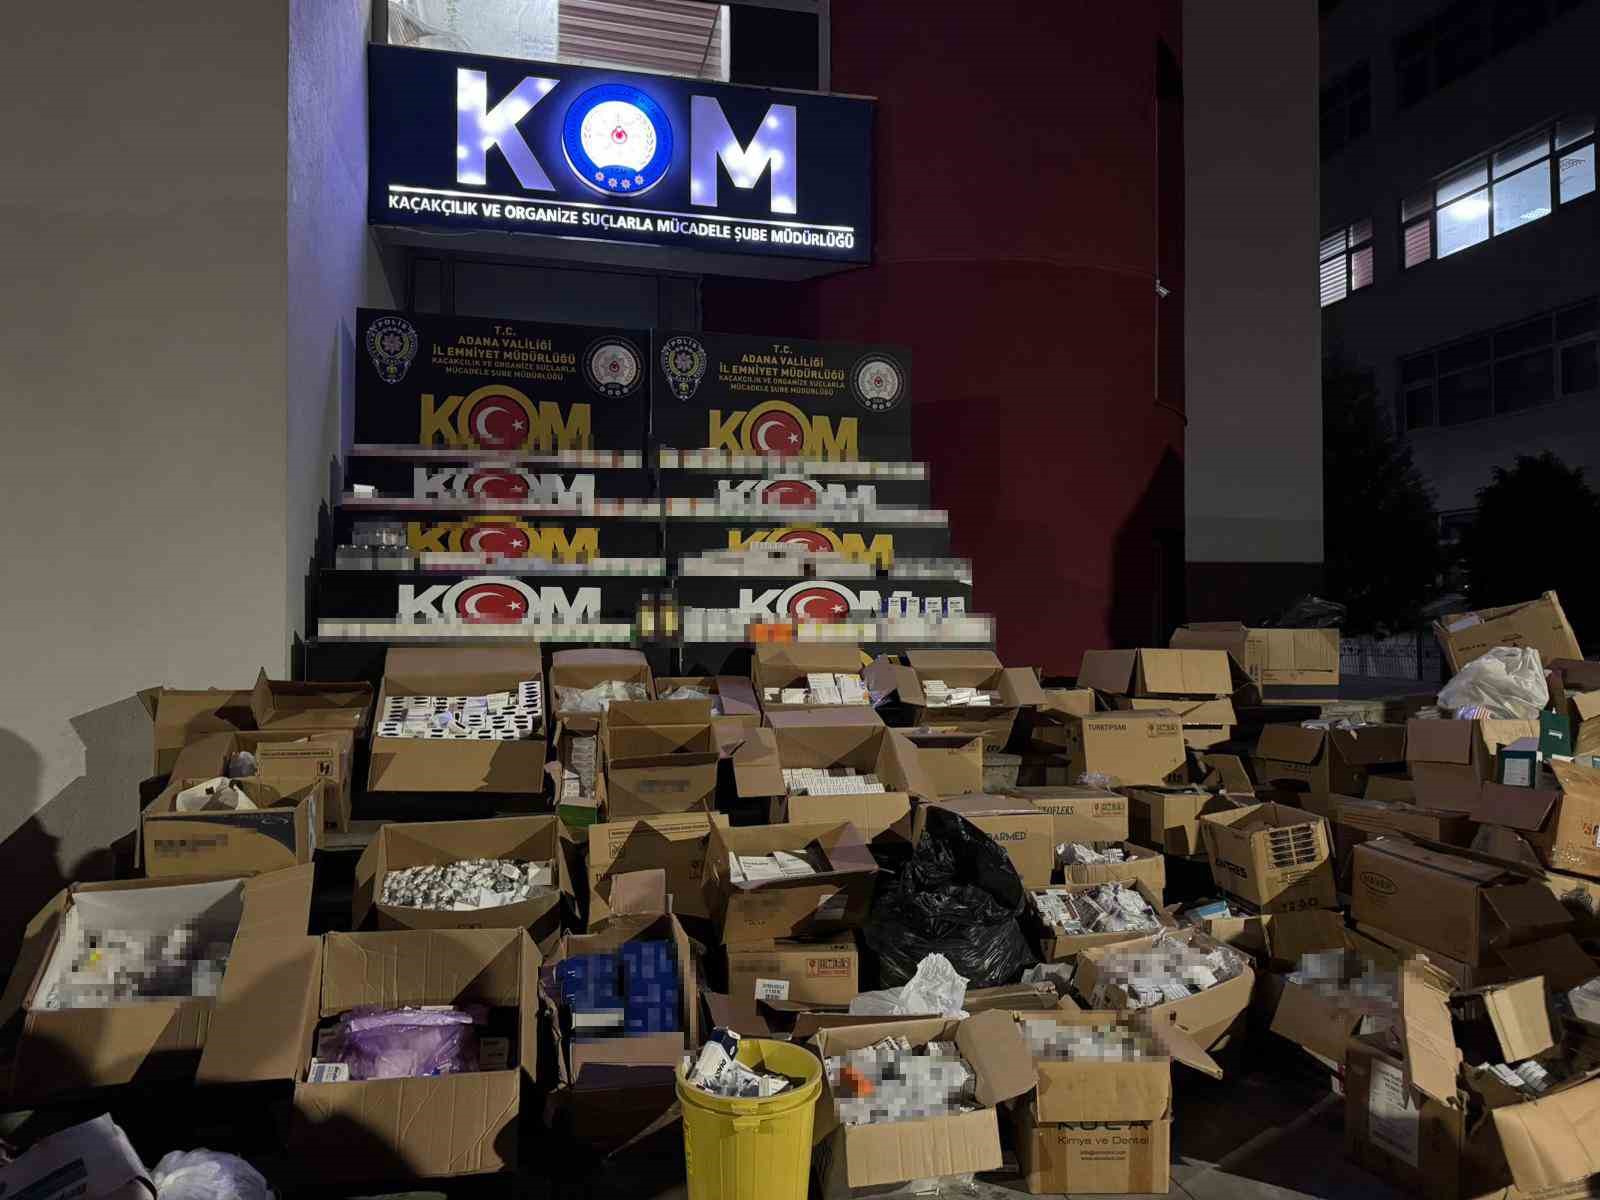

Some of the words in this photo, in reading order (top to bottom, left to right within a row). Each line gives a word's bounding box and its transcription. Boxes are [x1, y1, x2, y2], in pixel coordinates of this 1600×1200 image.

[388, 194, 478, 217] KAÇAKÇILIK
[482, 202, 501, 218] VE
[504, 204, 579, 225] ORGANİZE
[581, 212, 653, 232] SUÇLARLA
[656, 217, 731, 239] MÜCADELE
[734, 225, 768, 243] ŞUBE
[771, 229, 855, 250] MÜDÜRLÜĞÜ
[457, 335, 499, 348] ADANA
[494, 325, 516, 337] T.C.
[432, 343, 445, 356] İL
[447, 345, 500, 359] EMNİYET
[503, 350, 576, 365] MÜDÜRLÜĞÜ
[741, 353, 778, 365] ADANA
[772, 344, 793, 355] T.C.
[719, 360, 730, 374] İL
[732, 364, 778, 377] EMNİYET
[781, 367, 845, 381] MÜDÜRLÜĞÜ
[420, 384, 592, 452] KOM
[708, 400, 859, 462] KOM
[397, 576, 602, 624] KOM
[1057, 1135, 1092, 1146] Kimya
[1112, 1135, 1150, 1146] Dental
